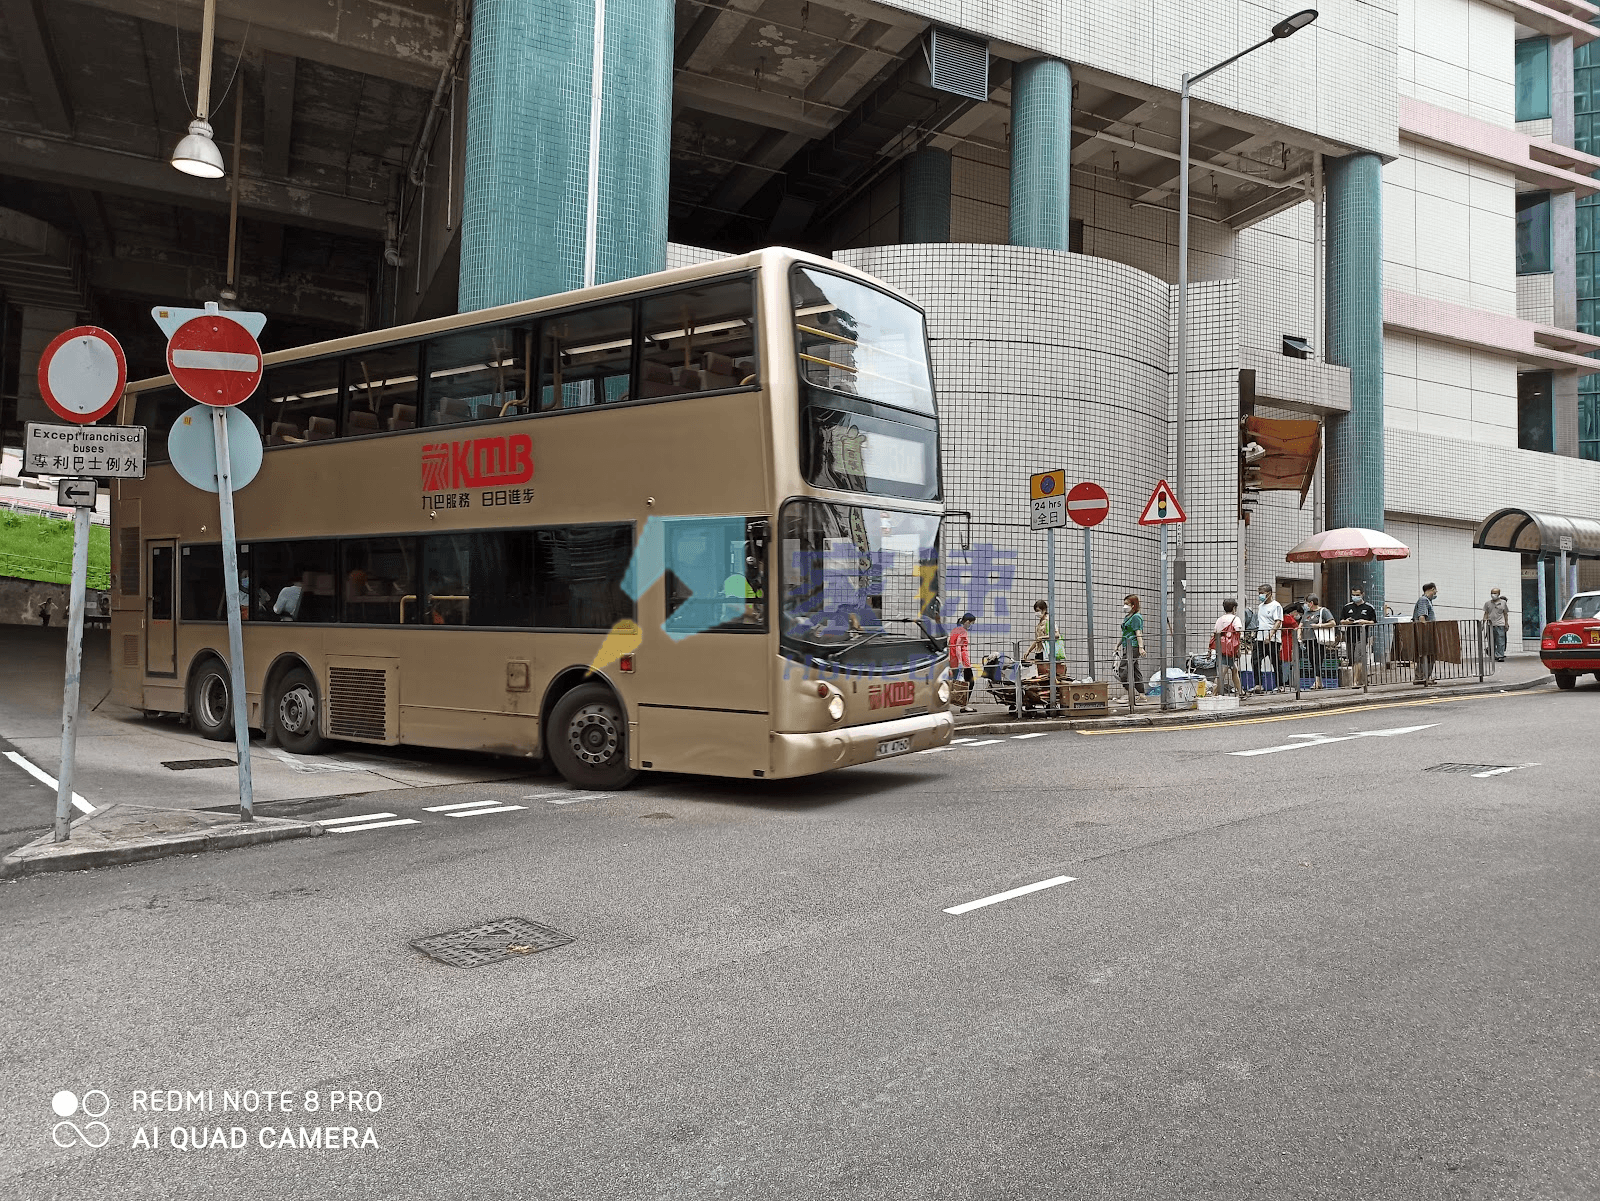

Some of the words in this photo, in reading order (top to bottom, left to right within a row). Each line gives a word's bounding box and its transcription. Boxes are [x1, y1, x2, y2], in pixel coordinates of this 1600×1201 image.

[33, 428, 79, 442] Except
[81, 431, 140, 442] franchised
[73, 443, 104, 453] buses
[31, 453, 138, 473] 專利巴士例外
[452, 433, 535, 490] KMB
[421, 492, 470, 510] 九巴服務
[482, 488, 535, 507] 日日進步
[1034, 501, 1046, 511] 24
[1048, 499, 1062, 509] hrs
[1037, 511, 1059, 526] 全日
